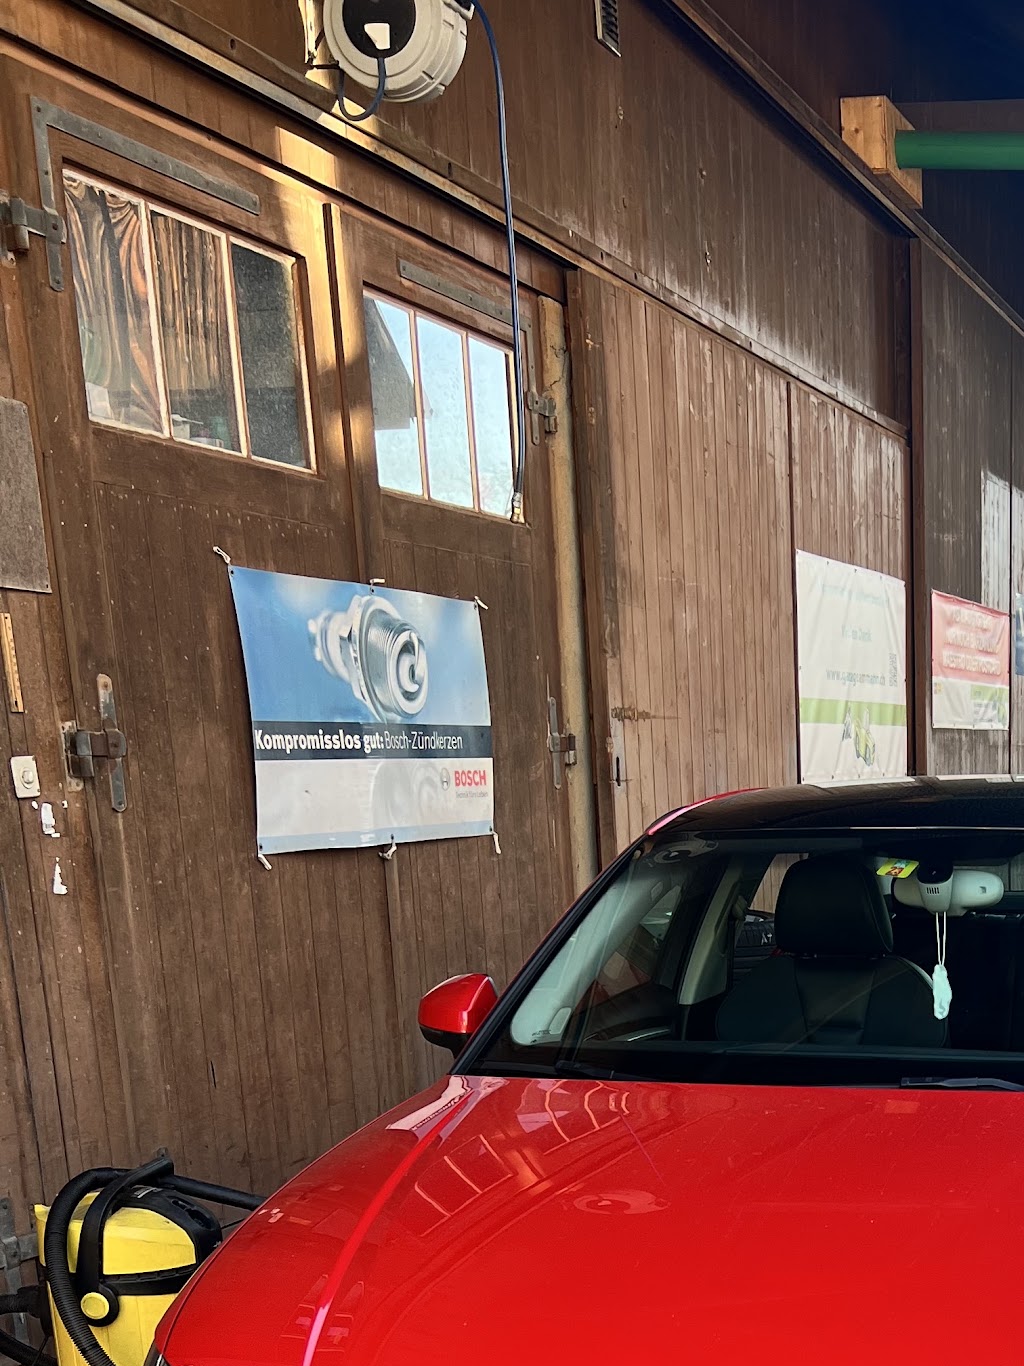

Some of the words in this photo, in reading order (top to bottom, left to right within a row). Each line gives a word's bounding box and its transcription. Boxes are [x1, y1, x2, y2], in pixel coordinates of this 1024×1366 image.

[254, 729, 361, 754] Kompromisslos
[363, 732, 384, 753] gut:
[384, 731, 464, 750] Bosch-Zündkerzen
[454, 769, 487, 787] BOSCH
